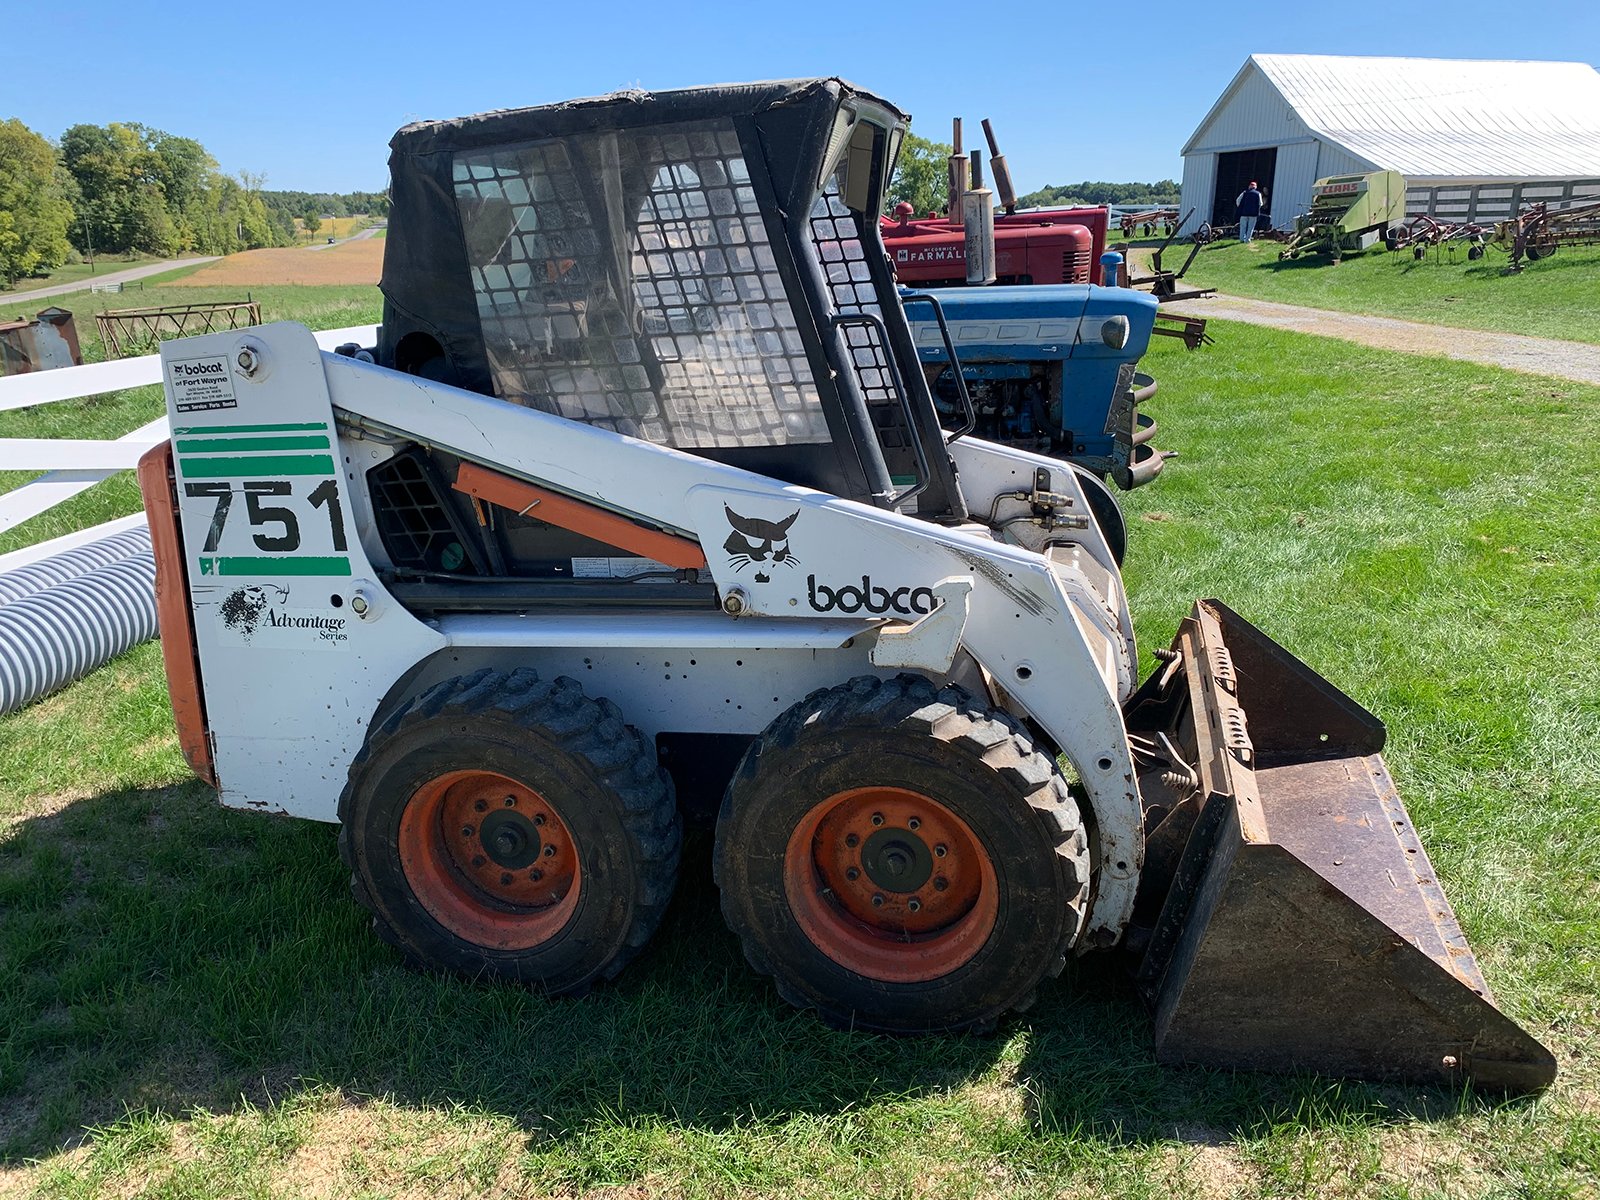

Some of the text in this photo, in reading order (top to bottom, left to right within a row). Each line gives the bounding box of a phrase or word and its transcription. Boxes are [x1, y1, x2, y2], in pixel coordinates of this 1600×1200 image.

[1322, 183, 1357, 193] CLAAS
[184, 362, 223, 375] bobcat
[184, 480, 348, 553] 751
[807, 574, 938, 614] bobca
[263, 608, 346, 632] Advantage
[319, 631, 348, 641] Series
